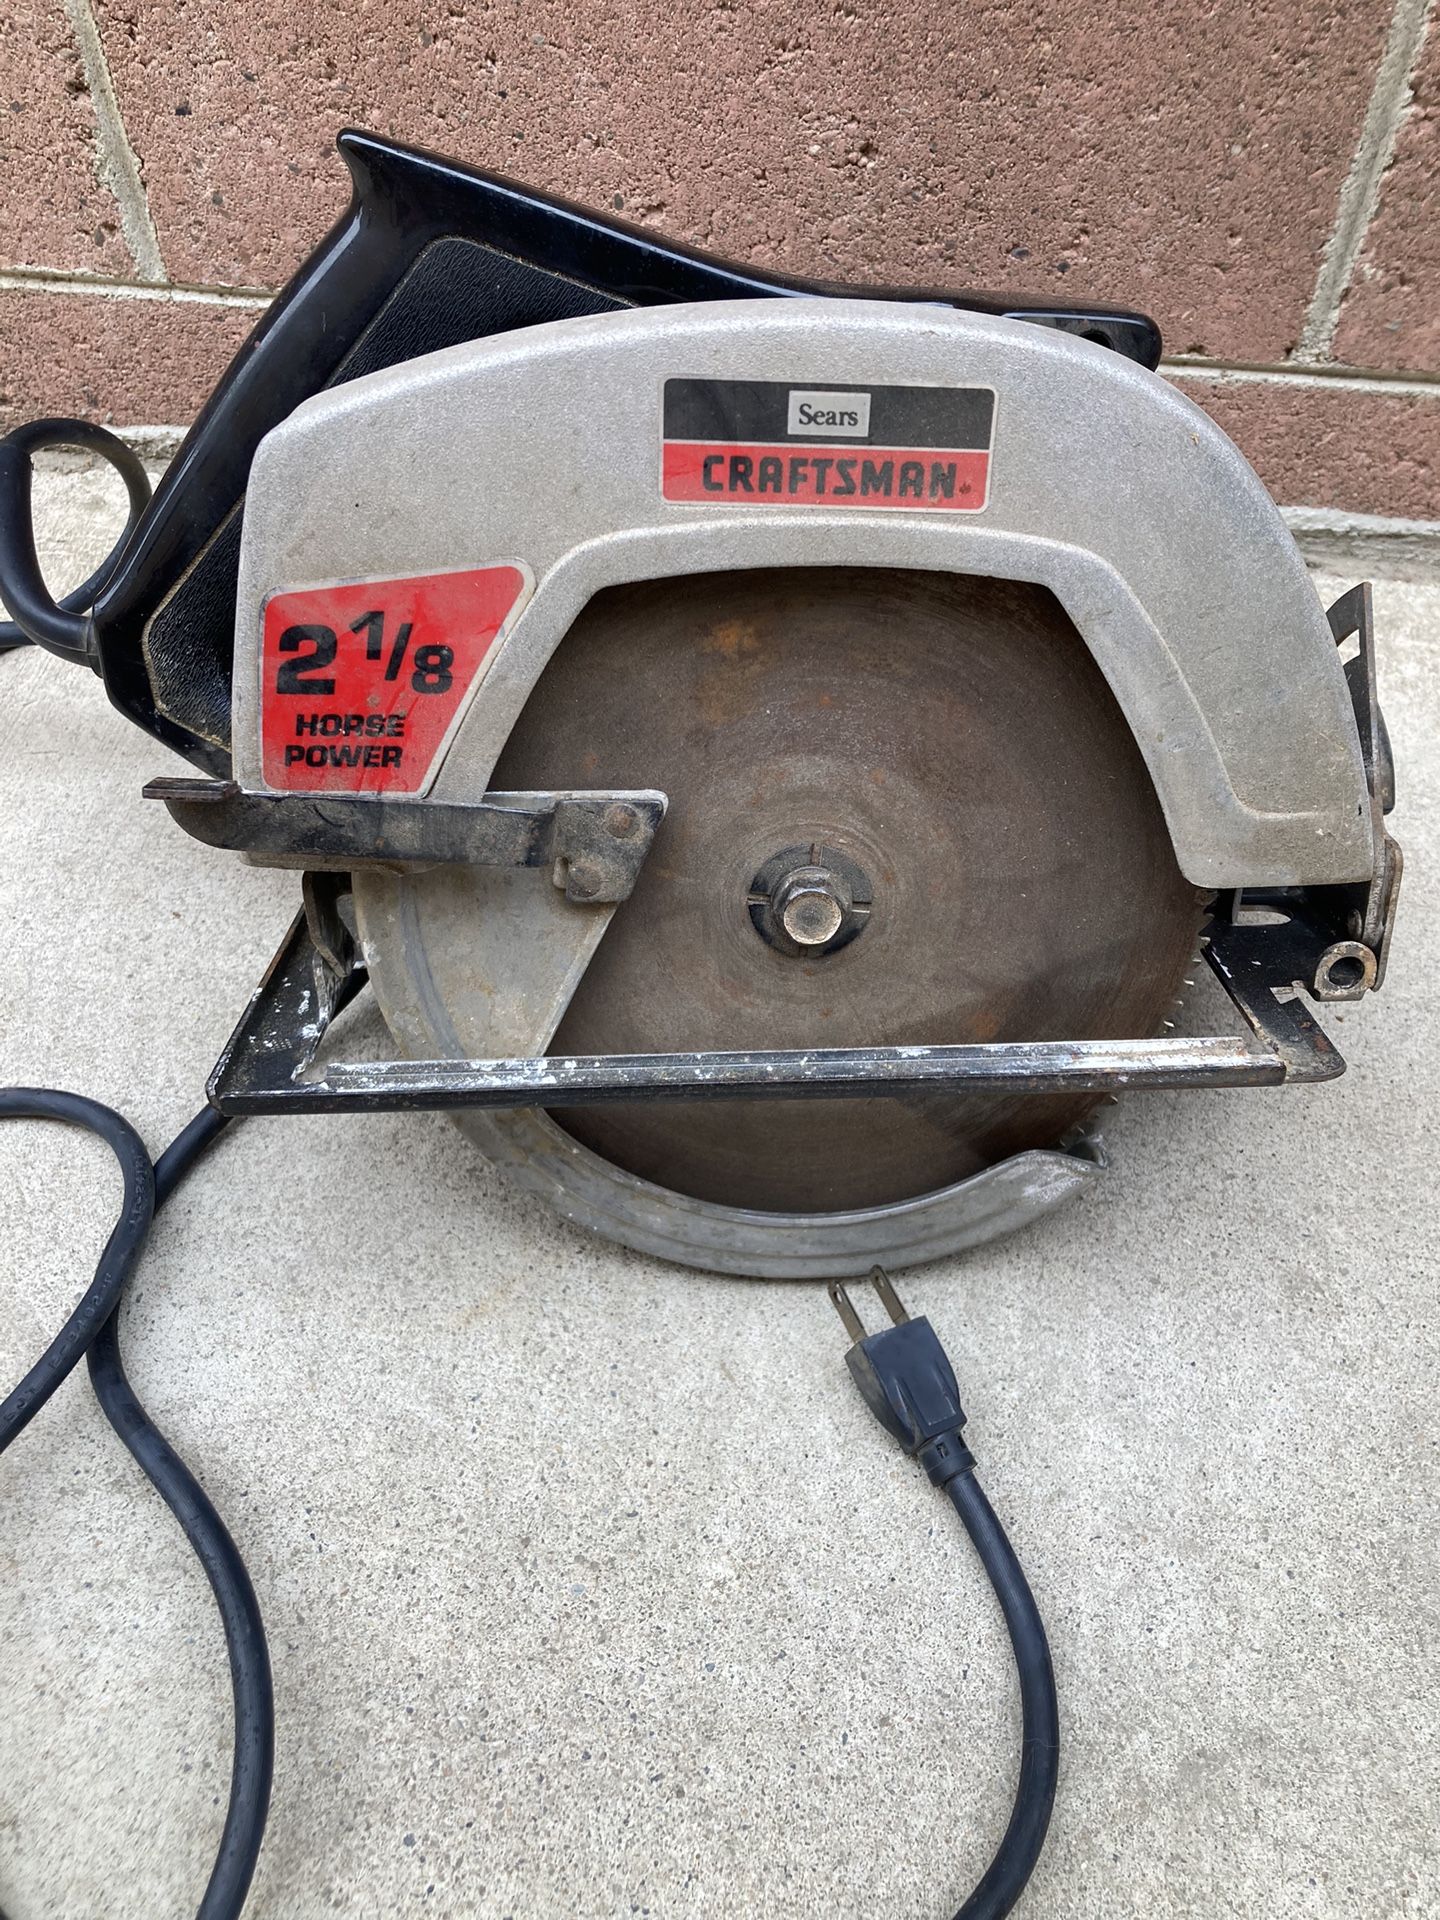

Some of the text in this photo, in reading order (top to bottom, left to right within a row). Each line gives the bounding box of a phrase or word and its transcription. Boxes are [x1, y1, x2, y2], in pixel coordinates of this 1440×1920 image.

[798, 403, 859, 427] Sears
[702, 455, 957, 498] CRAFTSMAN
[296, 713, 406, 737] HORSE
[285, 744, 403, 768] POWER
